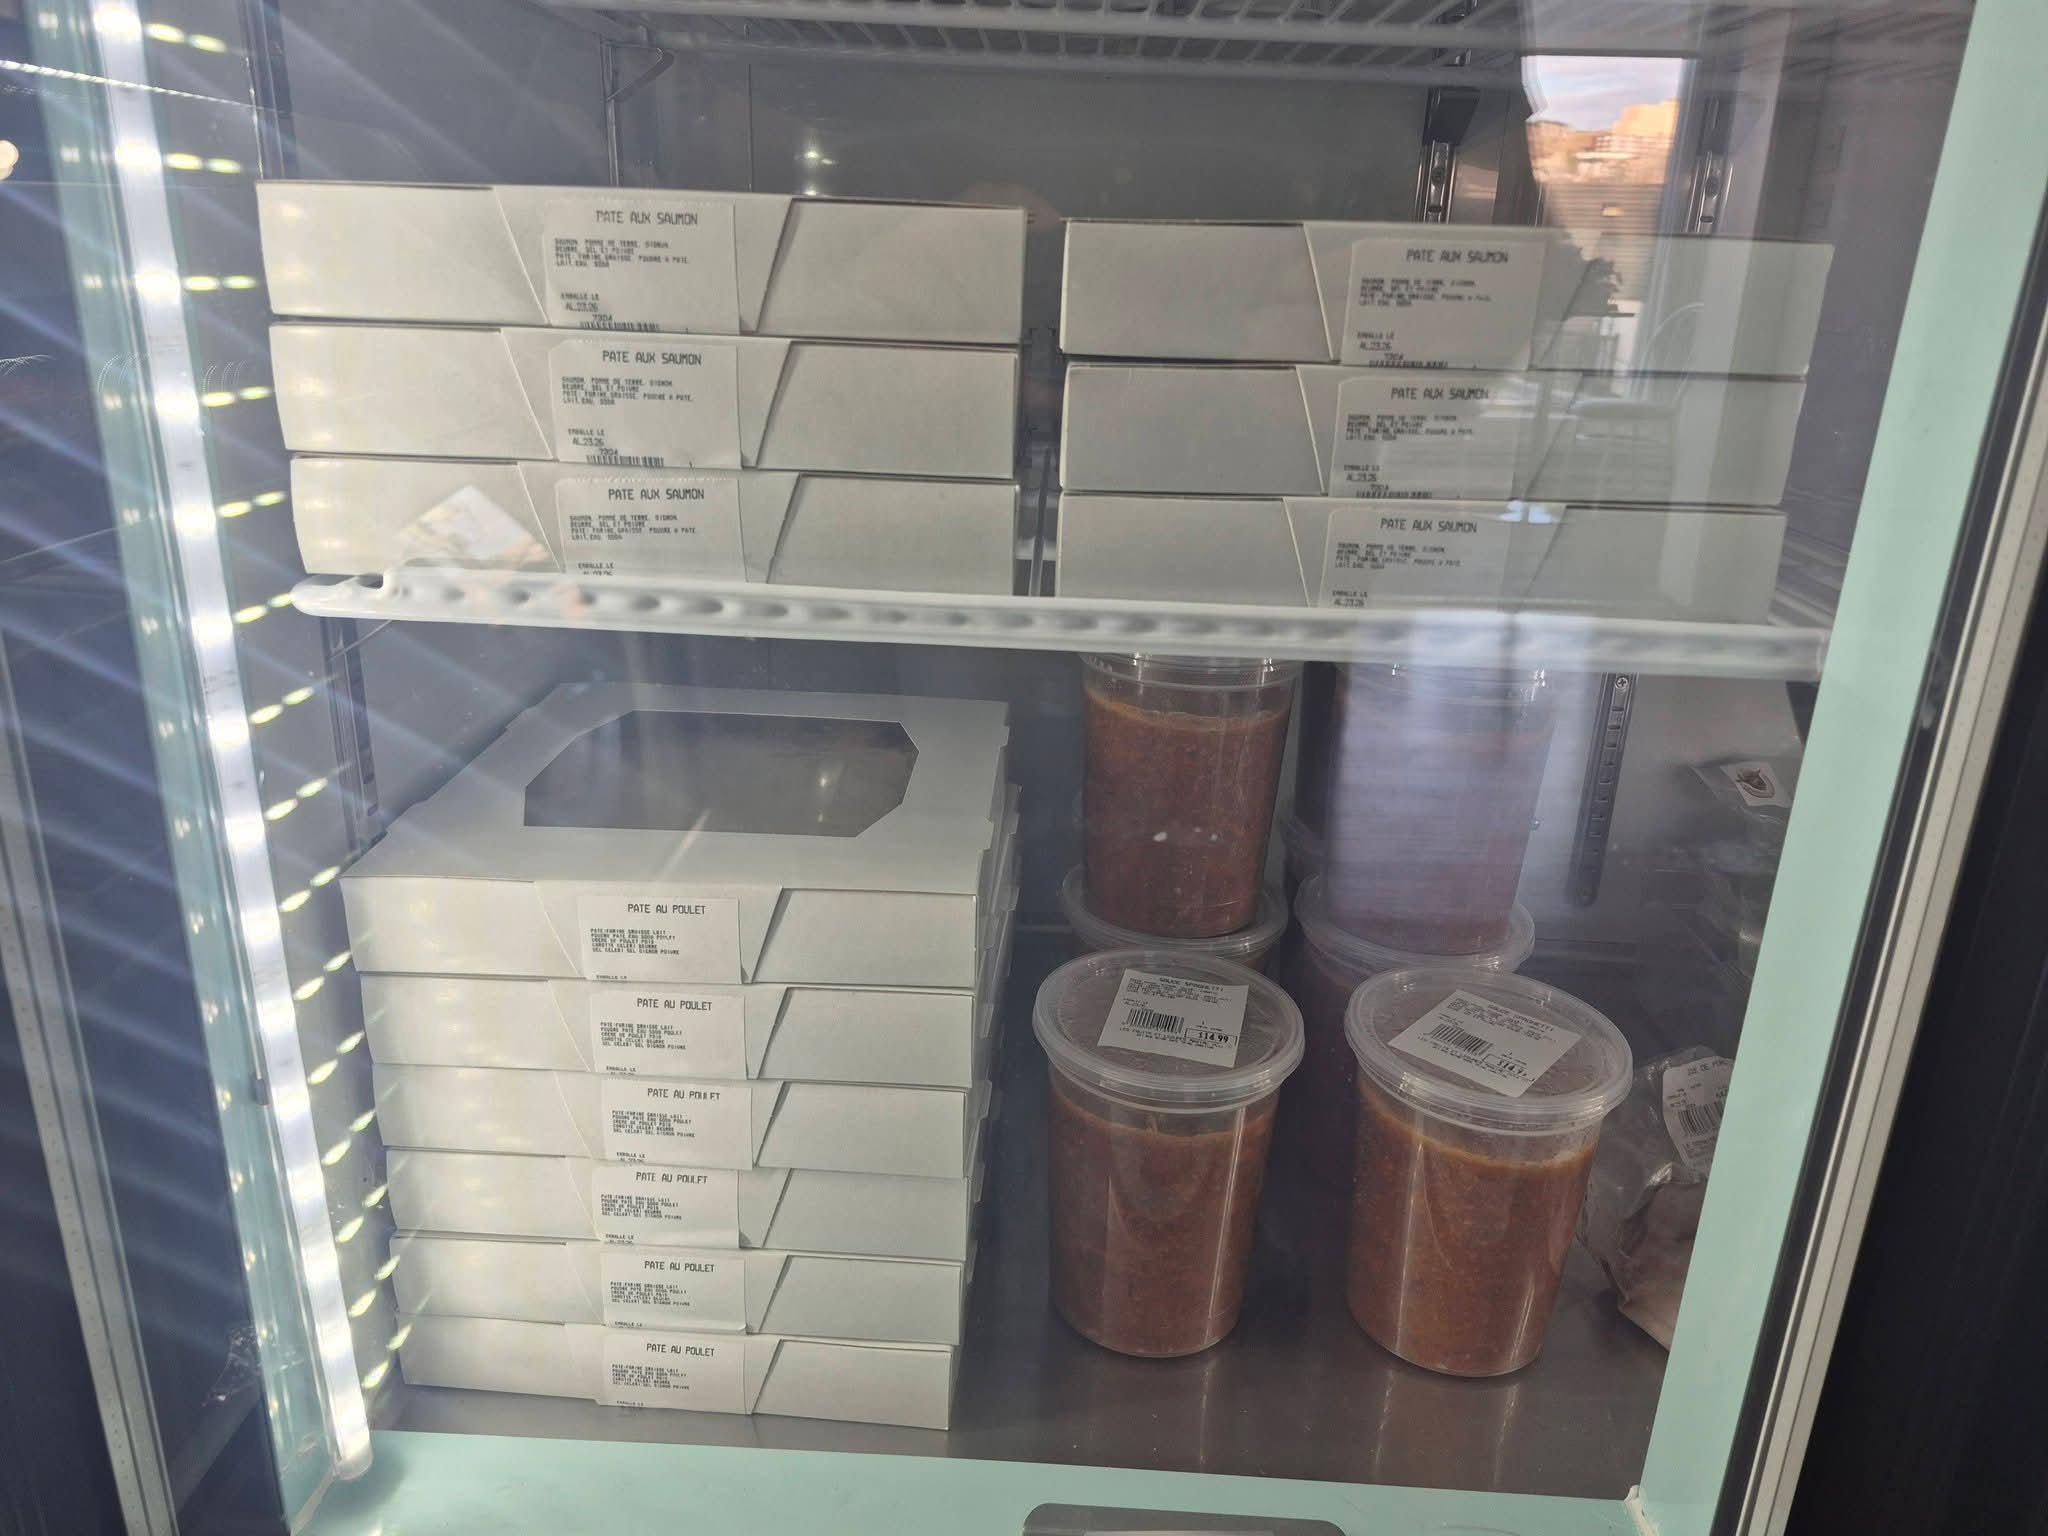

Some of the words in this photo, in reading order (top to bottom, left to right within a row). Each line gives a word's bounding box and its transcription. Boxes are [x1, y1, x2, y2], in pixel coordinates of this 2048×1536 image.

[596, 210, 624, 224] PATE
[630, 212, 651, 224] AUX
[657, 213, 698, 225] SAUMON
[1406, 249, 1434, 263] PATE
[1440, 250, 1461, 263] AUX
[1467, 251, 1509, 264] SAUMON
[603, 350, 629, 363] PATE
[635, 352, 655, 364] AUX
[661, 353, 702, 366] SAUMON
[1391, 387, 1417, 399] PATE
[1423, 388, 1444, 400] AUX
[1448, 388, 1489, 400] SAUMON
[608, 488, 634, 500] PATE
[640, 489, 660, 500] AUX
[666, 489, 705, 500] SAUMON
[1380, 518, 1406, 530] PATE
[1412, 519, 1433, 531] AUX
[1438, 520, 1478, 533] SAUMON
[628, 903, 650, 913] PATE
[656, 904, 667, 914] AU
[672, 905, 706, 915] POULET
[637, 998, 659, 1008] PATE
[664, 1000, 675, 1009] AU
[680, 1000, 712, 1011] POULET
[647, 1088, 668, 1098] PATE
[673, 1089, 685, 1099] AU
[636, 1171, 656, 1182] PATE
[662, 1173, 673, 1183] AU
[644, 1260, 665, 1270] PATE
[669, 1262, 681, 1271] AU
[684, 1263, 715, 1273] POULET
[646, 1343, 667, 1353] PATE
[670, 1345, 682, 1354] AU
[685, 1346, 715, 1357] POULET
